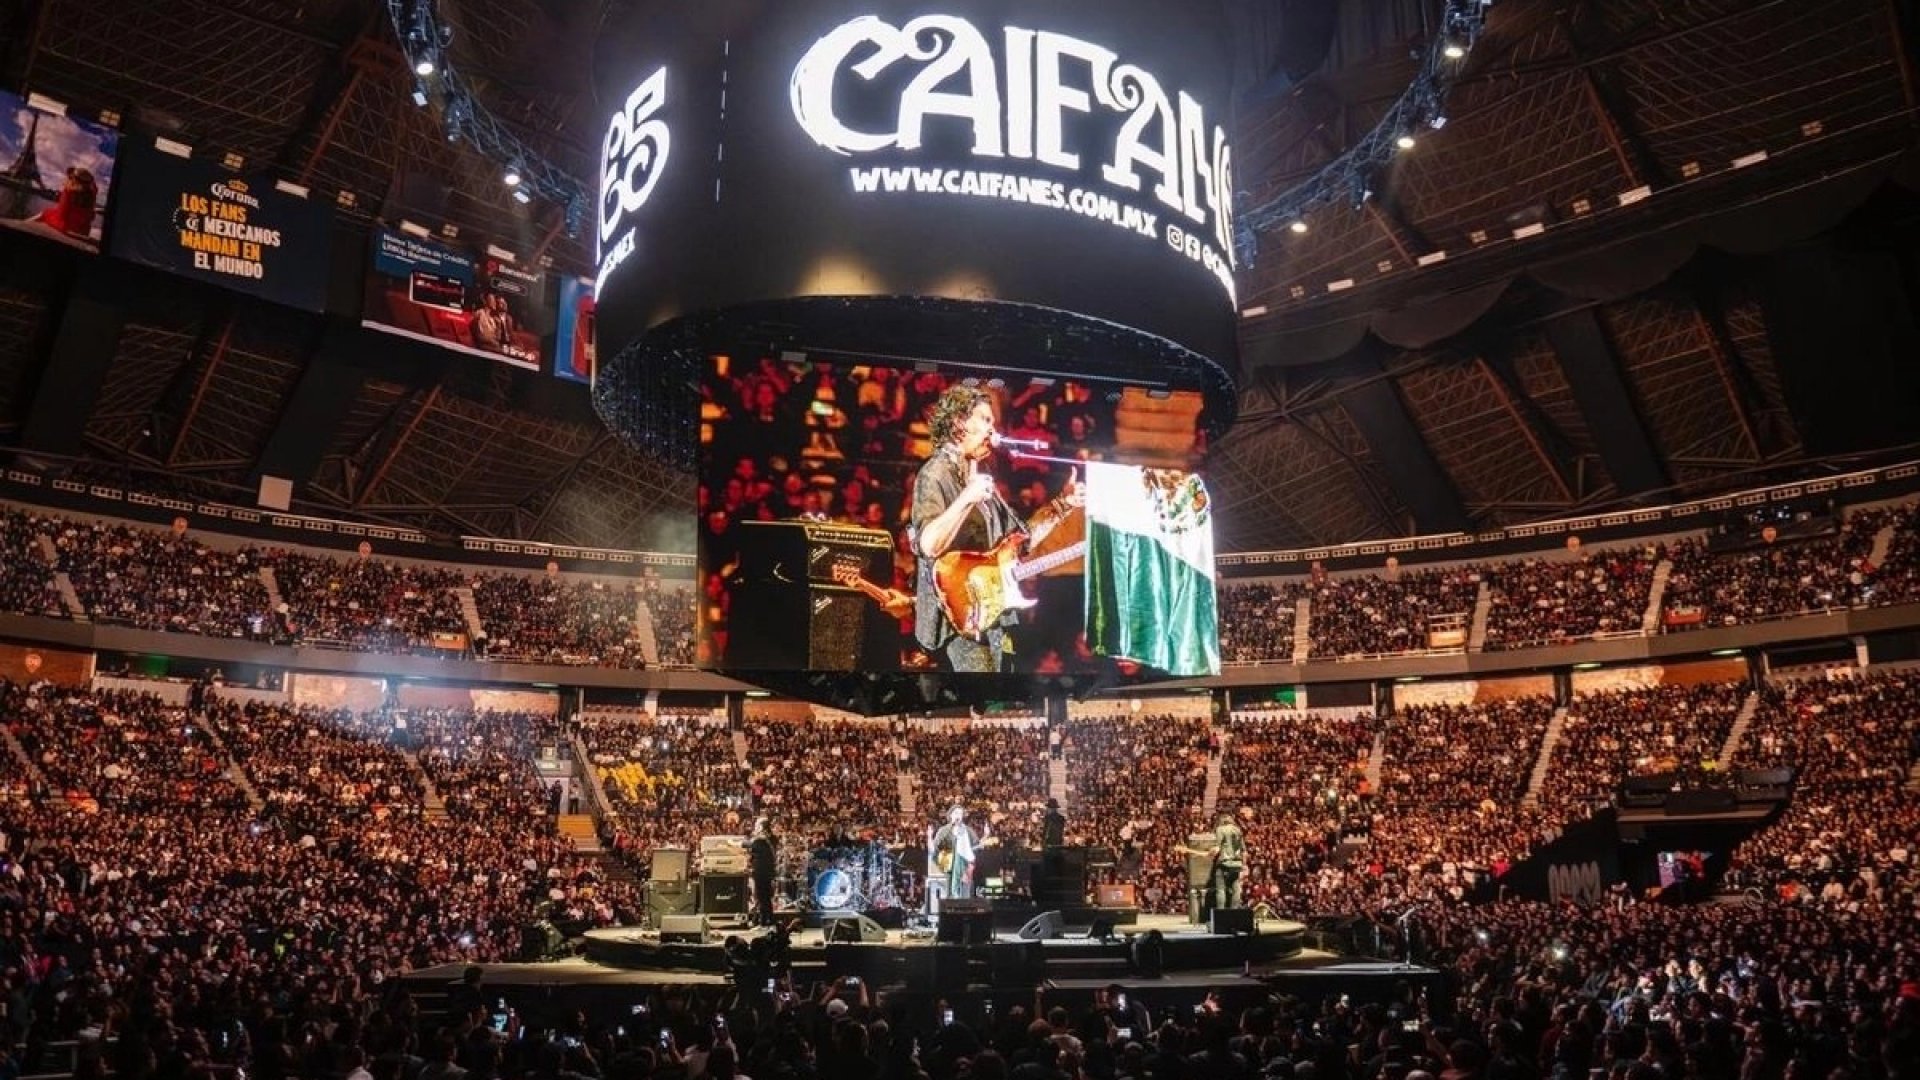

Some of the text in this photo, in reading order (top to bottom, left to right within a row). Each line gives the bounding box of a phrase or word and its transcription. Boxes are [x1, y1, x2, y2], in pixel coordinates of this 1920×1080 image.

[182, 193, 247, 223] LOS FANS
[850, 167, 1158, 239] WWW.CAIFANES.COM.MX
[181, 229, 261, 261] MANDAN EN
[204, 216, 281, 247] MEXICANOS
[194, 251, 264, 279] EL MUNDO
